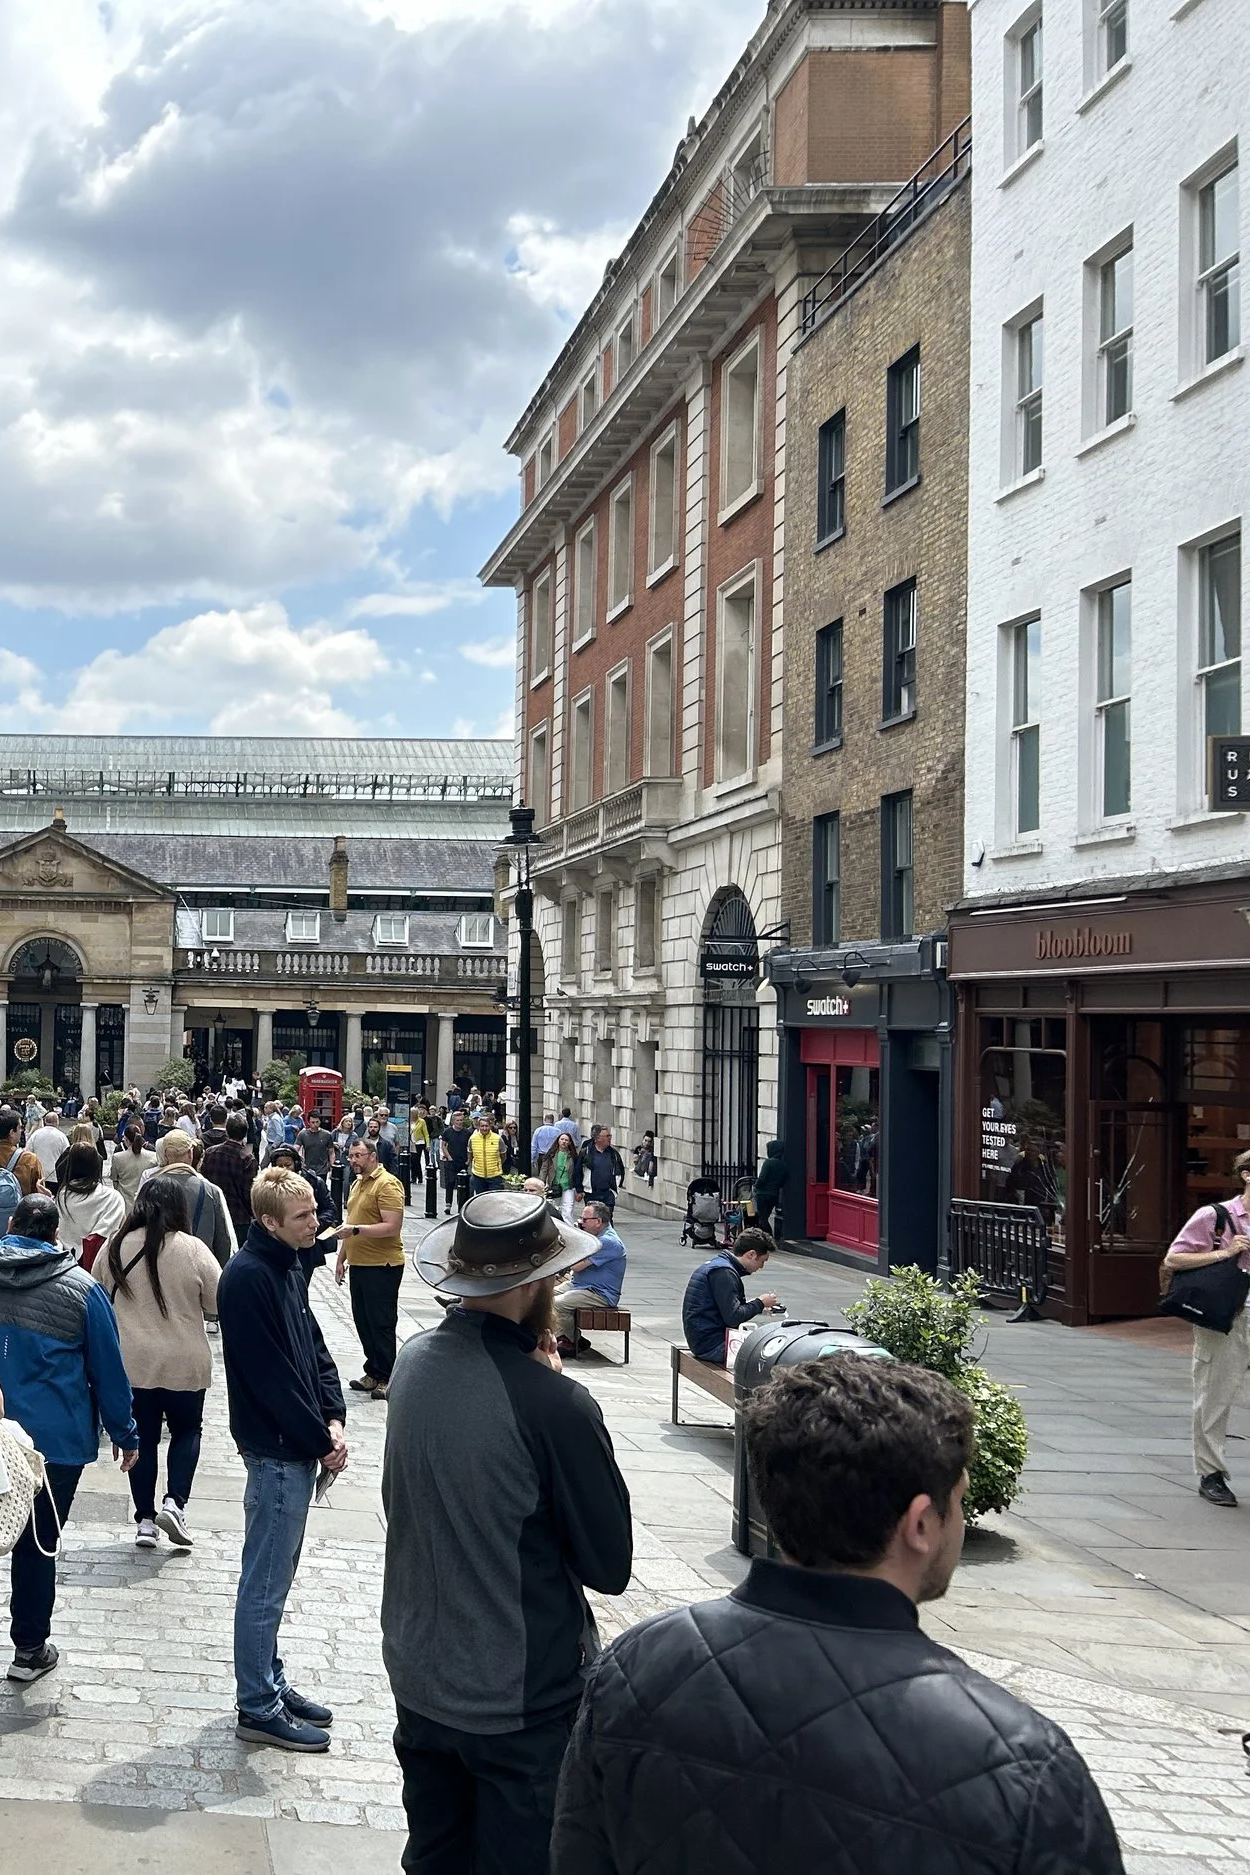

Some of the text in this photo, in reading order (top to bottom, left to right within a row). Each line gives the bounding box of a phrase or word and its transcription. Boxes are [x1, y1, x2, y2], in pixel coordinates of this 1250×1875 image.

[1036, 927, 1132, 959] bloobloom
[10, 946, 28, 973] COVENT
[30, 938, 62, 948] GARDEN
[982, 1107, 995, 1118] GET
[982, 1121, 1017, 1134] YOUR EYES
[982, 1135, 1006, 1147] TESTED
[982, 1149, 999, 1160] HERE
